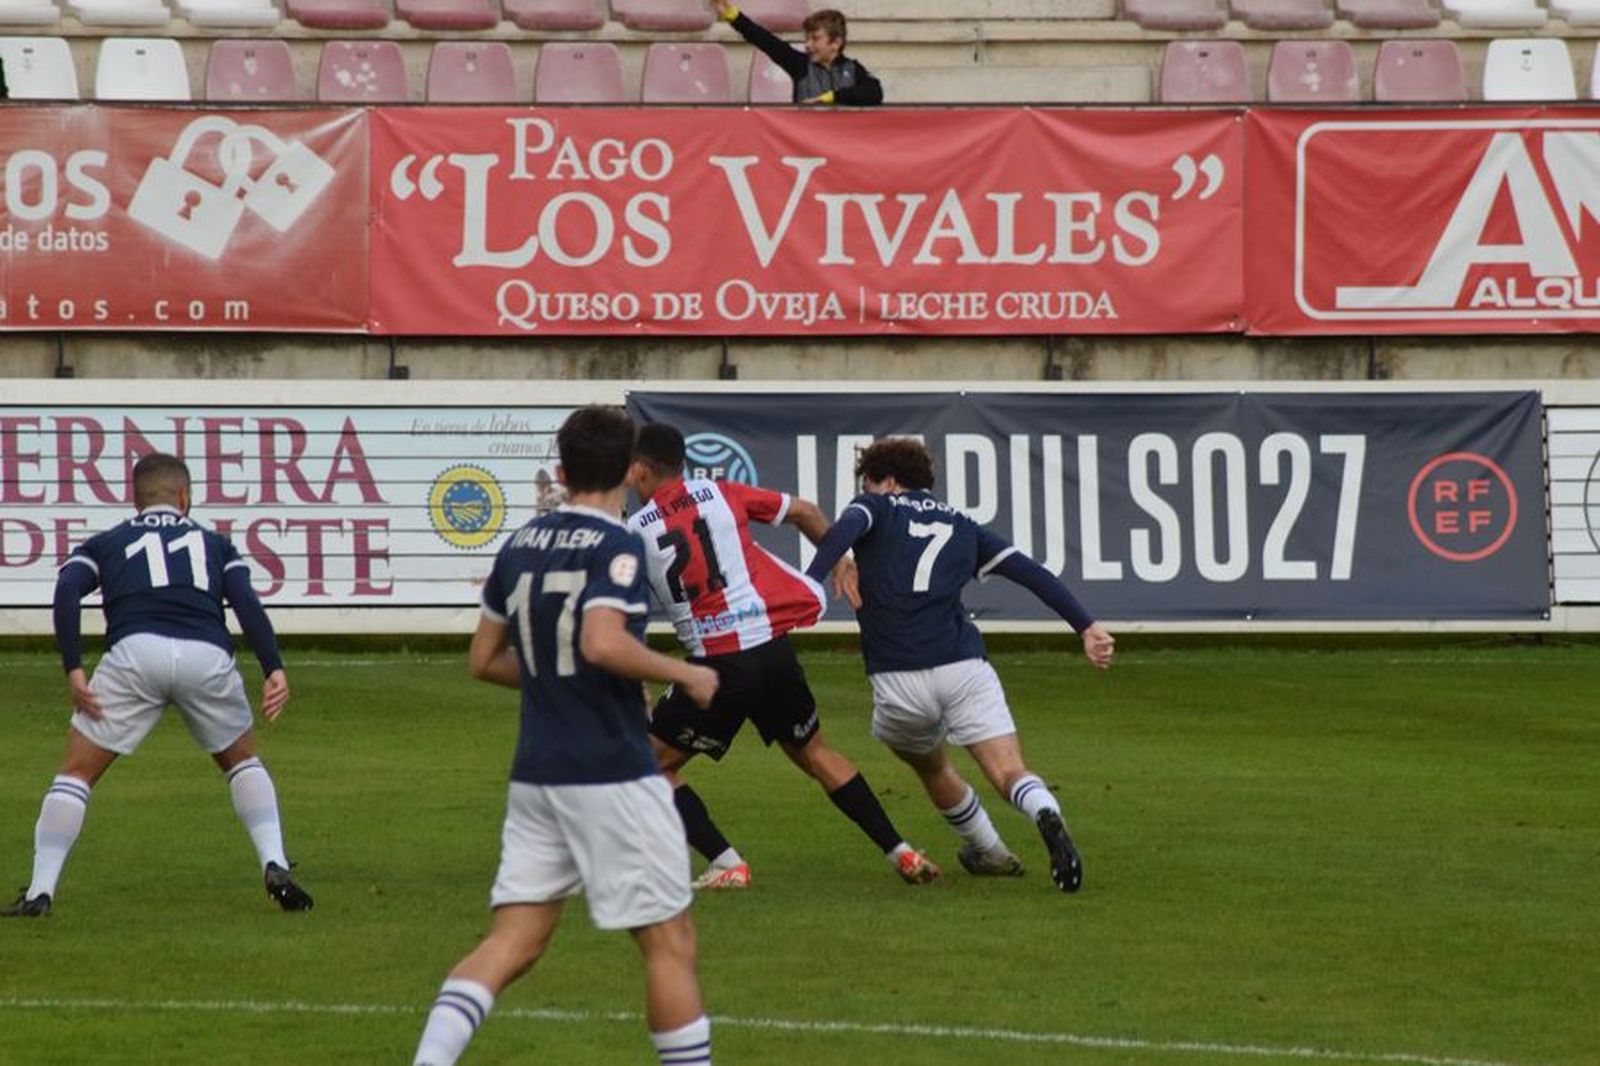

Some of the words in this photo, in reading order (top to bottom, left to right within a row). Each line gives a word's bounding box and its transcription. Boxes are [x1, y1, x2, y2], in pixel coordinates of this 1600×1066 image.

[506, 117, 674, 181] PAGO
[0, 223, 28, 252] de
[38, 223, 109, 252] datos
[495, 280, 640, 330] QUESO
[652, 293, 702, 321] DE
[716, 279, 846, 326] OVEJA
[879, 292, 988, 321] LECHE
[986, 291, 1118, 321] CRUDA
[130, 513, 194, 528] LORA
[639, 505, 671, 528] JOEL
[797, 432, 1366, 582] IPULSO27
[125, 530, 210, 591] 11
[656, 516, 729, 604] 21
[908, 519, 954, 592] 7
[505, 569, 588, 677] 17
